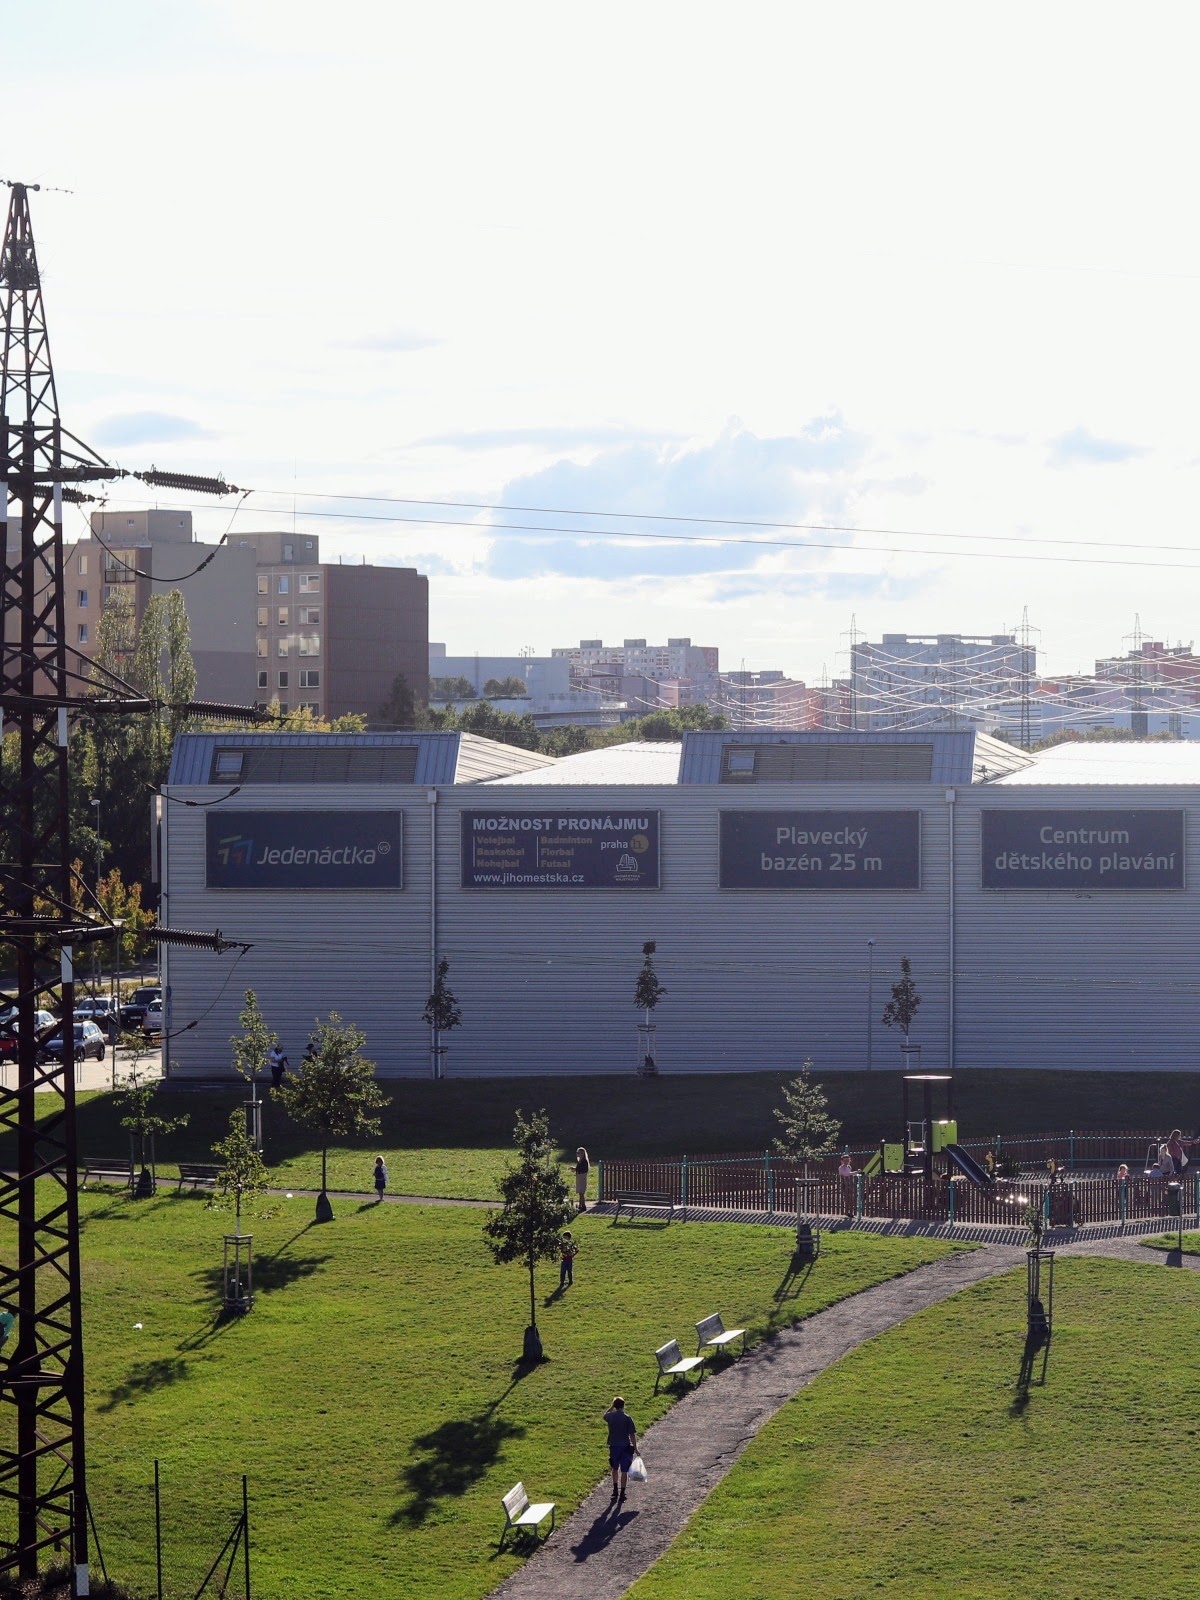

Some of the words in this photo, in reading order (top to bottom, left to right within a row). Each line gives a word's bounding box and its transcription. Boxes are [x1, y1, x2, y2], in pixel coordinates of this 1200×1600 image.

[472, 816, 553, 831] MOŽNOST
[557, 815, 649, 831] PRONÁJMU
[476, 836, 516, 846] Volejbal
[540, 836, 593, 845] Badminton
[776, 826, 868, 849] Plavecký
[1039, 826, 1129, 844] Centrum
[476, 847, 525, 856] Basketbal
[600, 839, 629, 850] praha
[256, 846, 377, 865] Jedenáctka
[761, 852, 822, 871] bazén
[829, 853, 856, 871] 25
[863, 856, 883, 871] m
[995, 852, 1093, 870] dětského
[1100, 852, 1177, 874] plavání
[473, 873, 585, 884] www.jihomestska.cz
